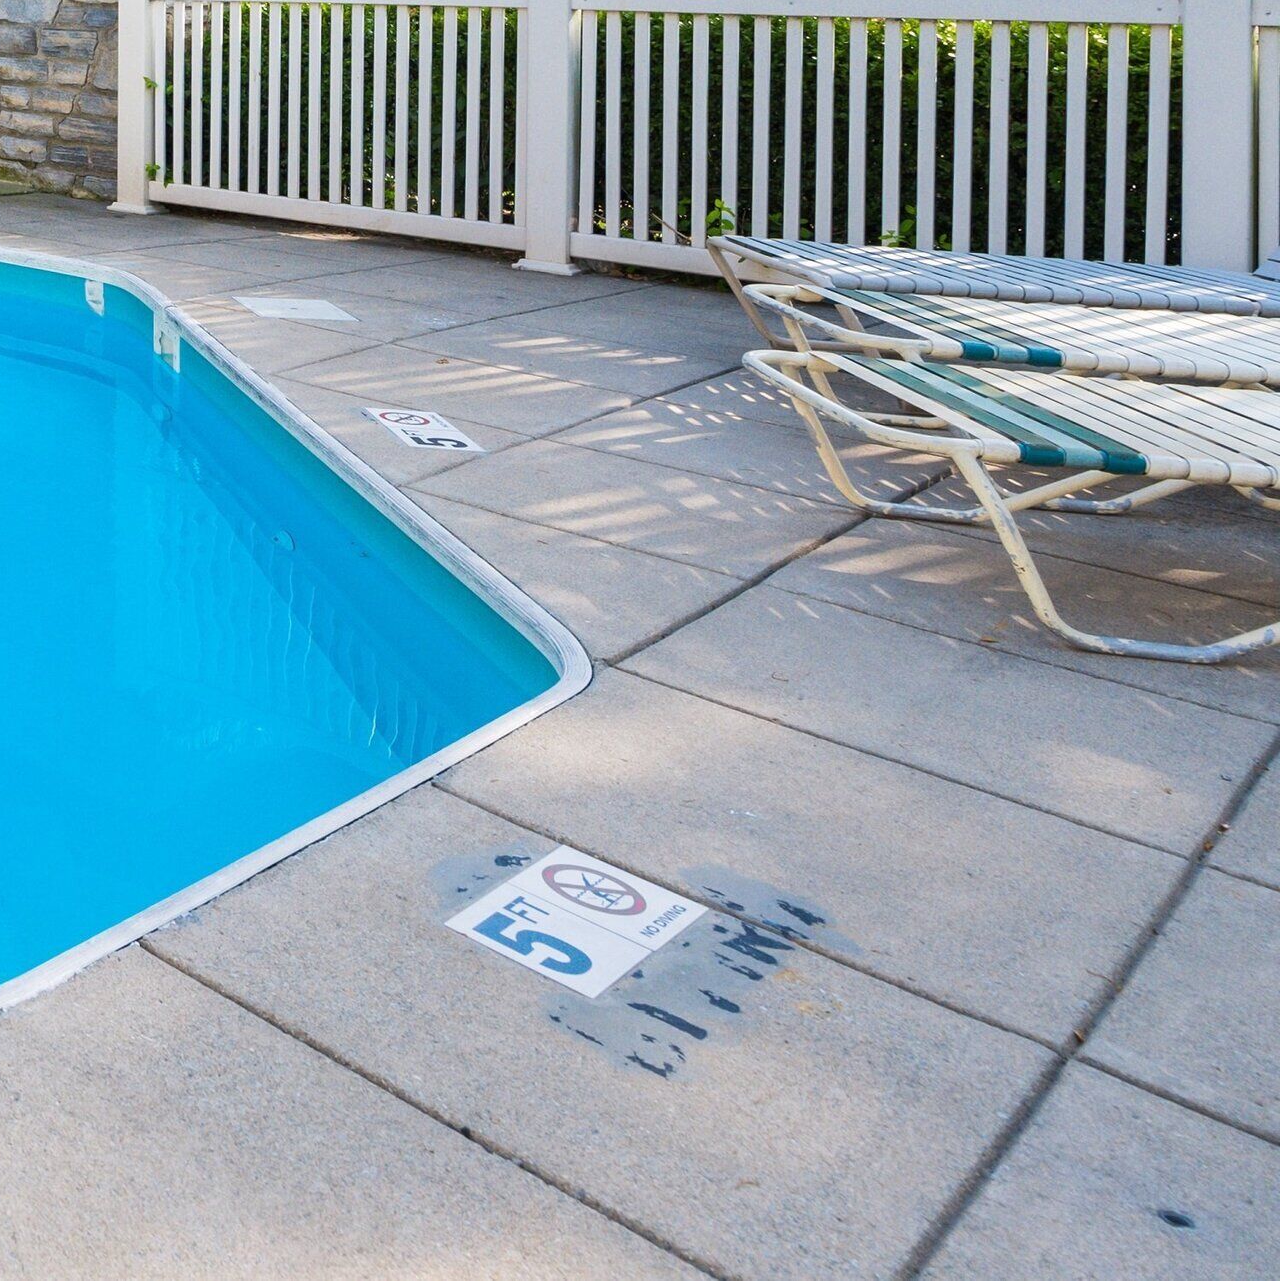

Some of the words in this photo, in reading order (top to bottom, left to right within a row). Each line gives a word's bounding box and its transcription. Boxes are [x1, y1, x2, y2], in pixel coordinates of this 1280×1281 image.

[410, 437, 468, 448] 5
[504, 896, 549, 923] FT
[640, 922, 660, 939] NO
[654, 904, 688, 930] DIVING
[472, 911, 592, 976] 5
